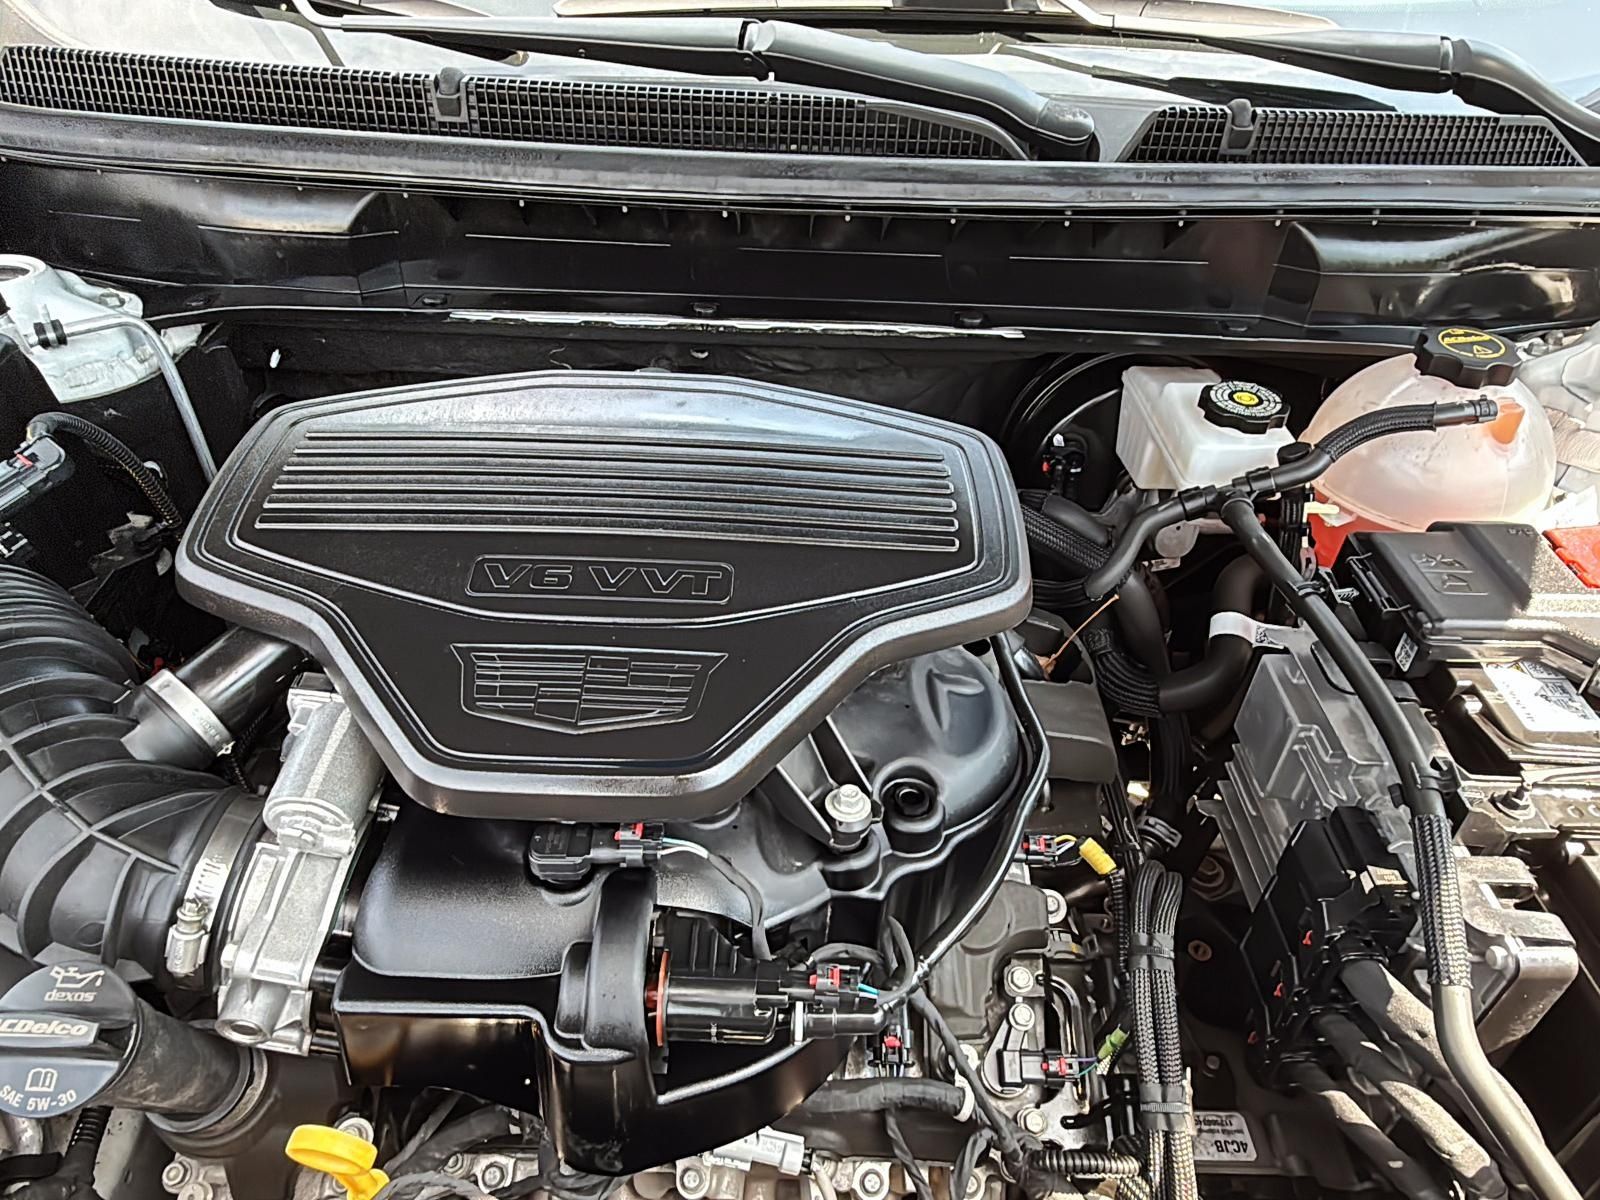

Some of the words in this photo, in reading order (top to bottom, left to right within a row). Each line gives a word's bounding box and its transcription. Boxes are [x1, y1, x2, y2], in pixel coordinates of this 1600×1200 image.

[484, 563, 573, 590] V6
[588, 566, 722, 595] VVT
[44, 989, 97, 1002] dexos
[0, 1018, 89, 1035] CDelco
[0, 1084, 24, 1108] SAE
[26, 1089, 77, 1111] 5W-30
[1214, 1139, 1248, 1153] 4CJB
